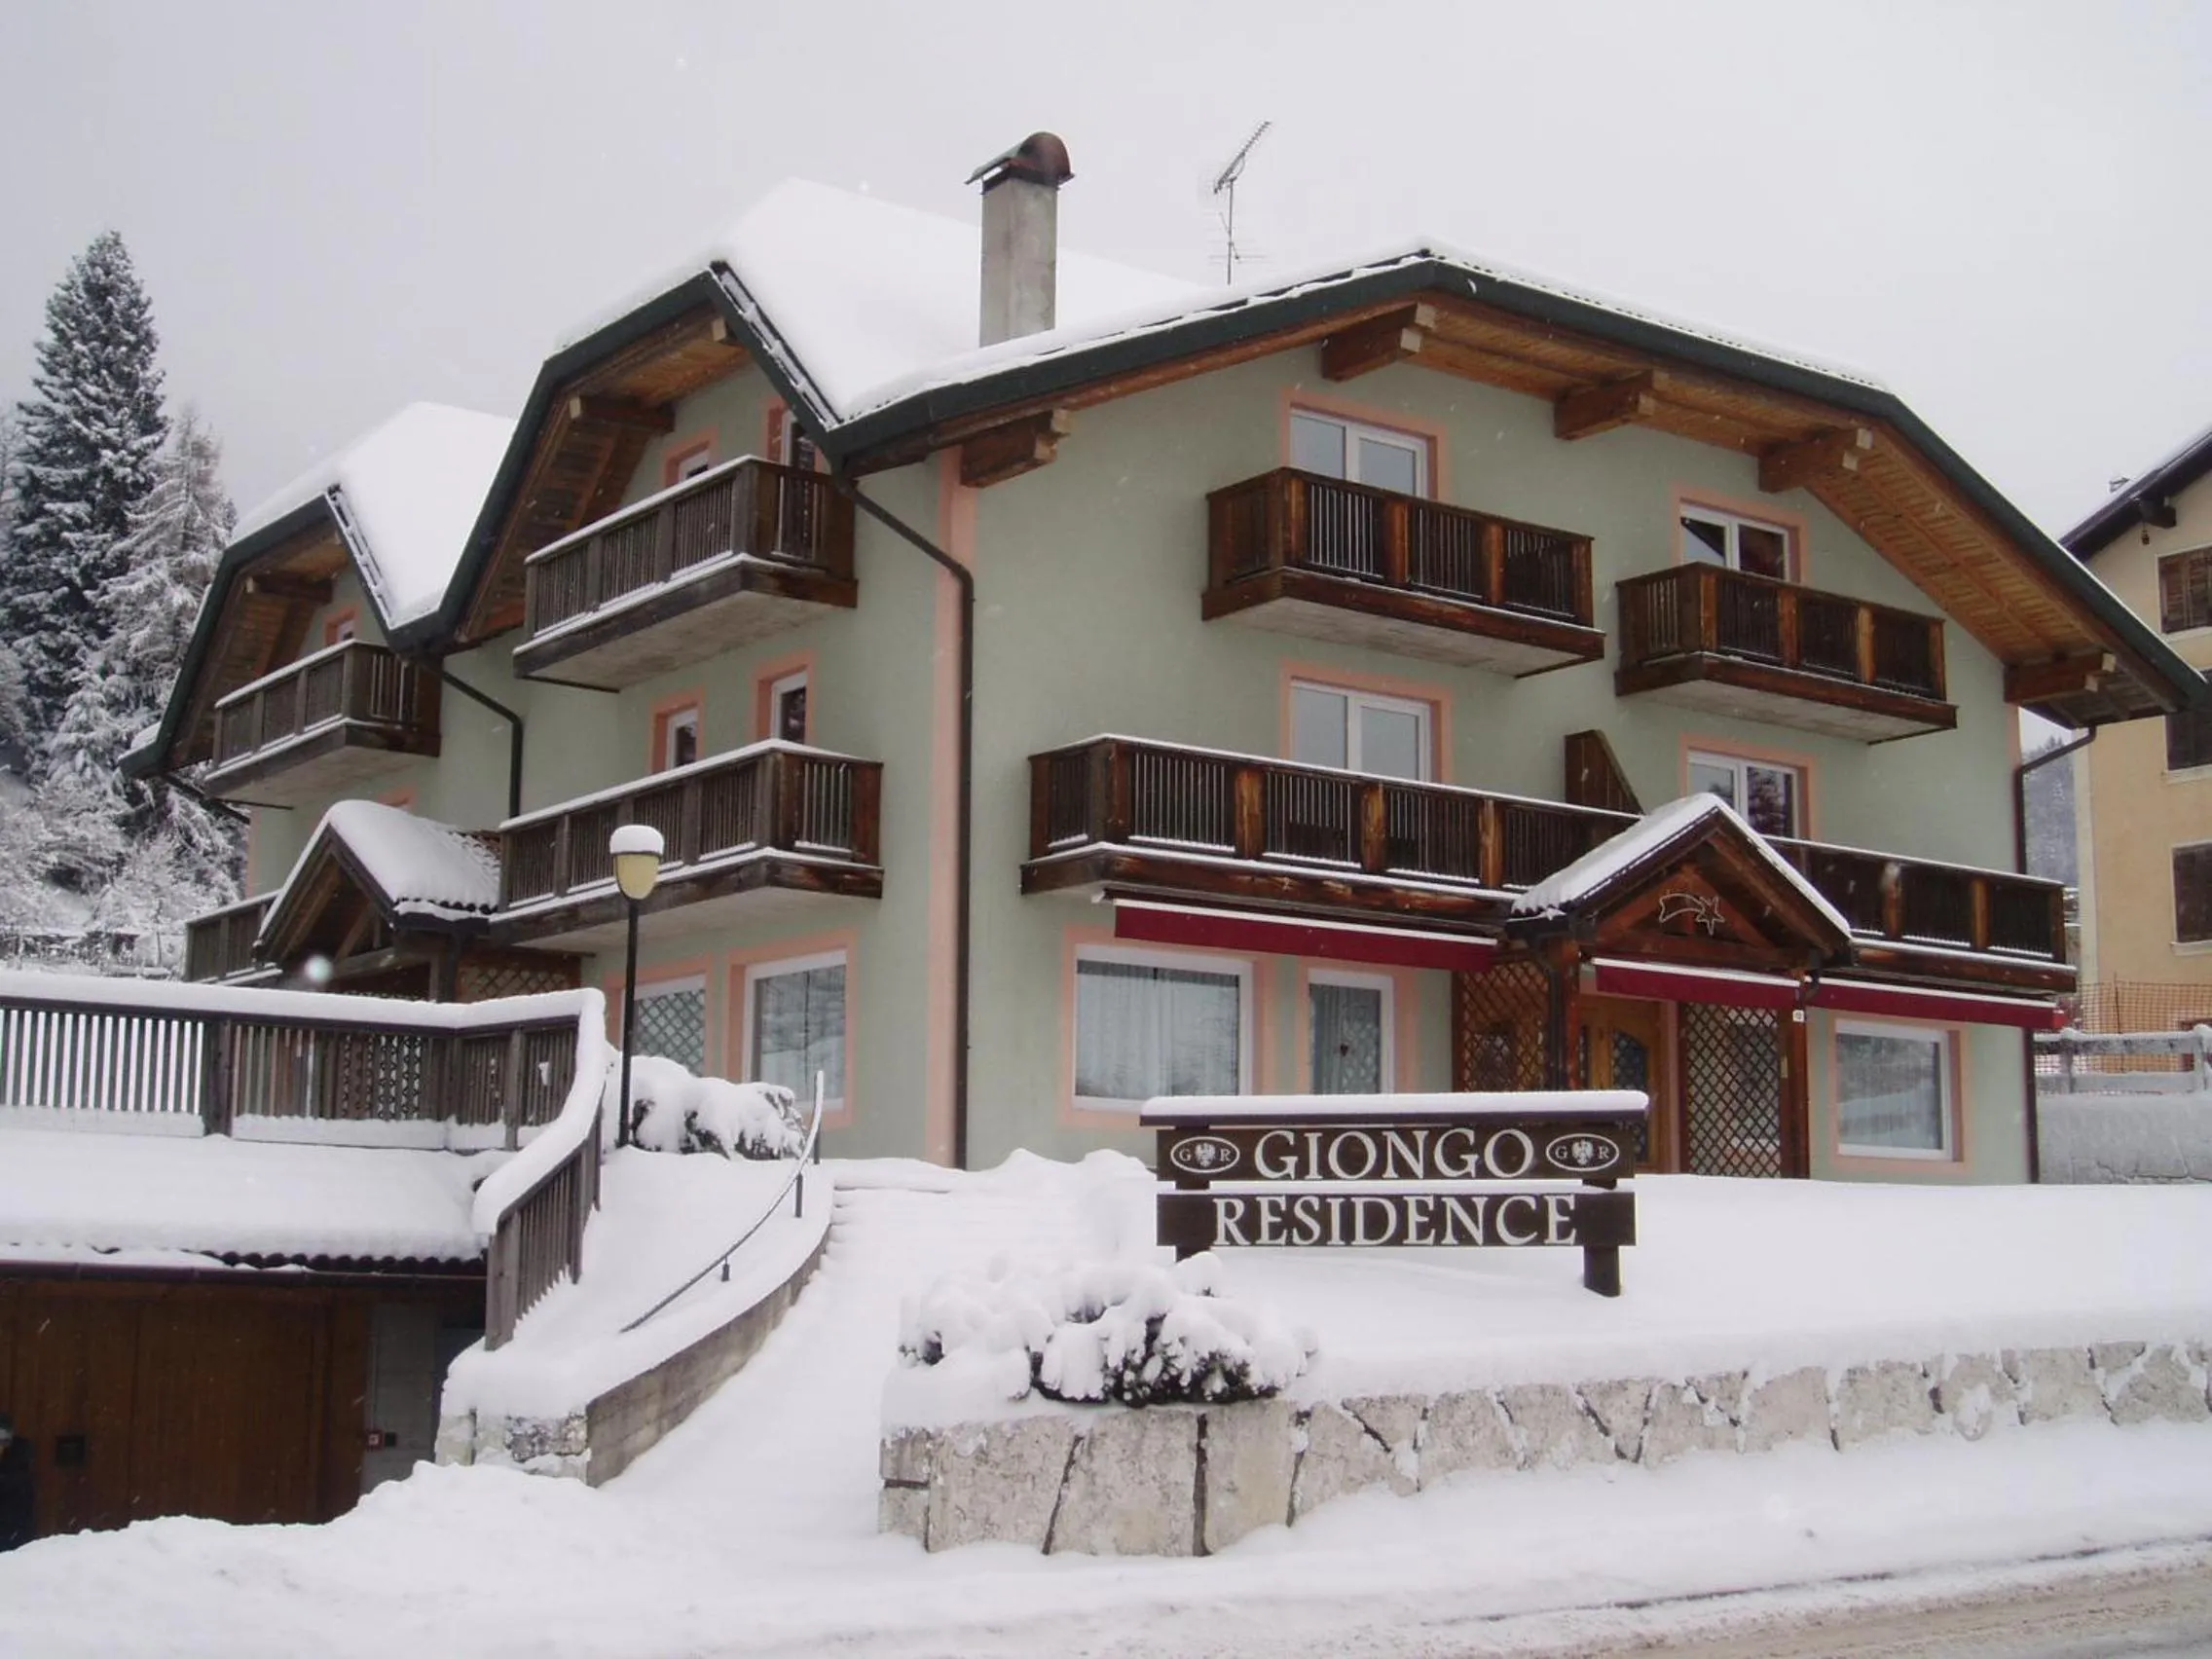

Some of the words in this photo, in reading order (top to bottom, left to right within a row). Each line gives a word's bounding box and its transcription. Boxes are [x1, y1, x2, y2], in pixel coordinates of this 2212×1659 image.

[1179, 1148, 1193, 1161] G
[1219, 1149, 1233, 1162] R
[1254, 1128, 1534, 1180] GIONGO
[1555, 1146, 1568, 1160] G
[1597, 1146, 1609, 1160] R
[1212, 1196, 1577, 1246] RESIDENCE
